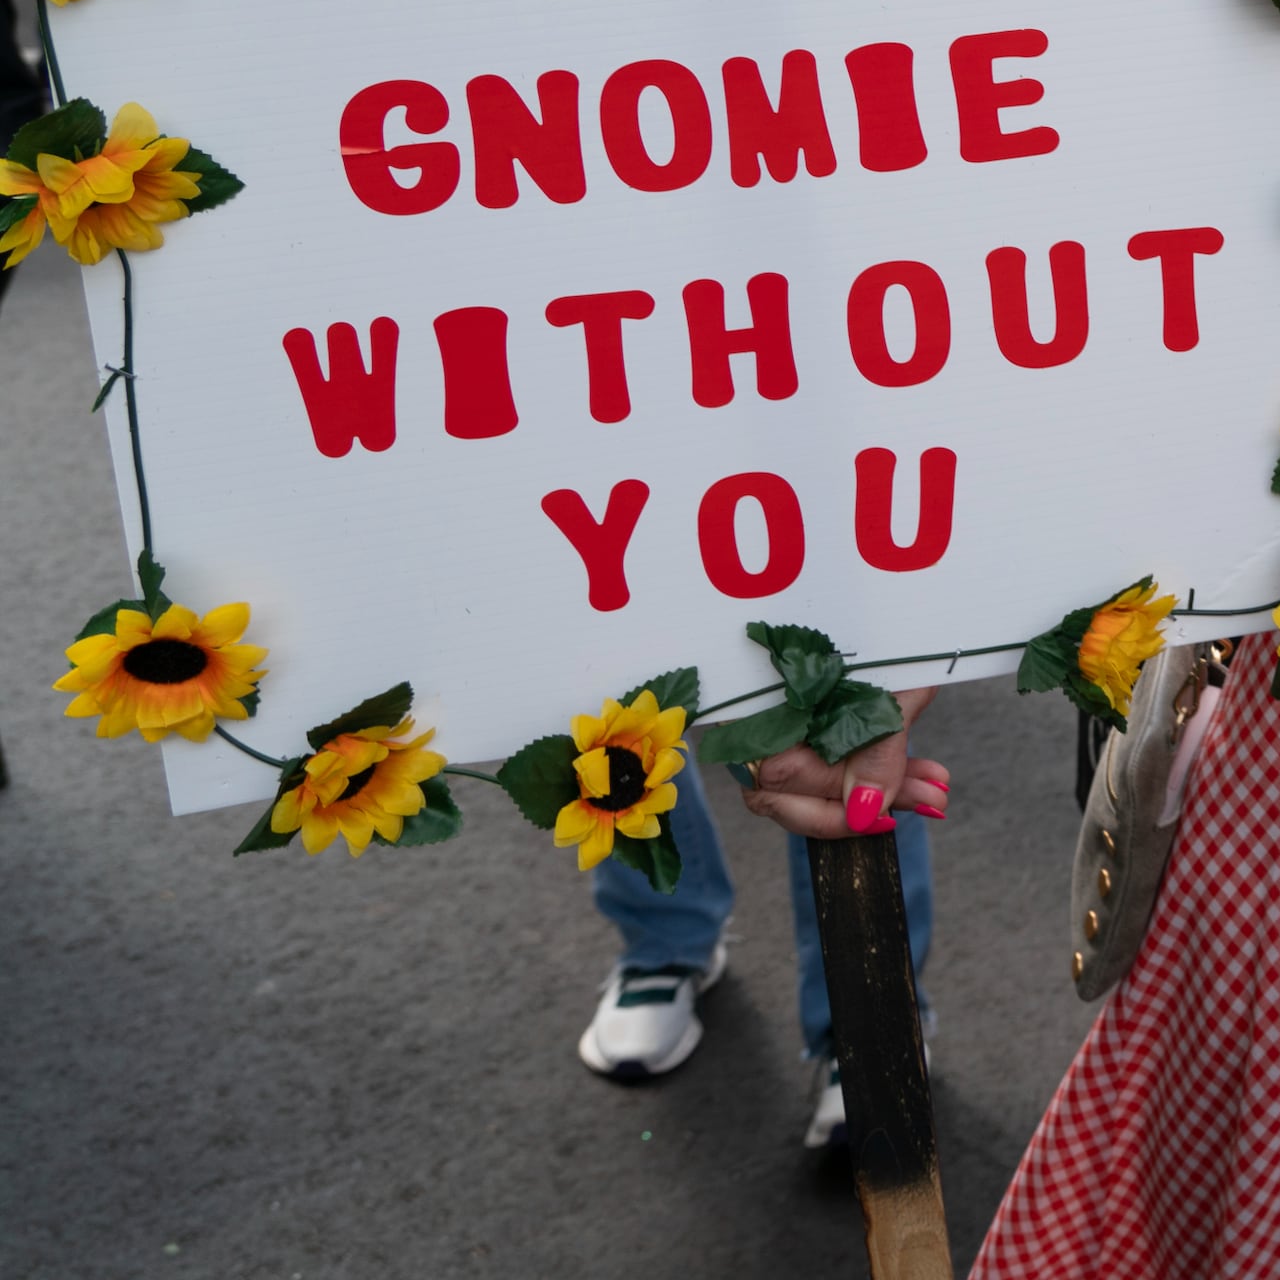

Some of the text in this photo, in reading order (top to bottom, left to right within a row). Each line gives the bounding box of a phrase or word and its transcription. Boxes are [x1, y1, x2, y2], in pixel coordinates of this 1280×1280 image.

[339, 28, 1060, 217] GNOMIE
[281, 226, 1225, 459] WITHOUT
[540, 446, 958, 613] YOU
